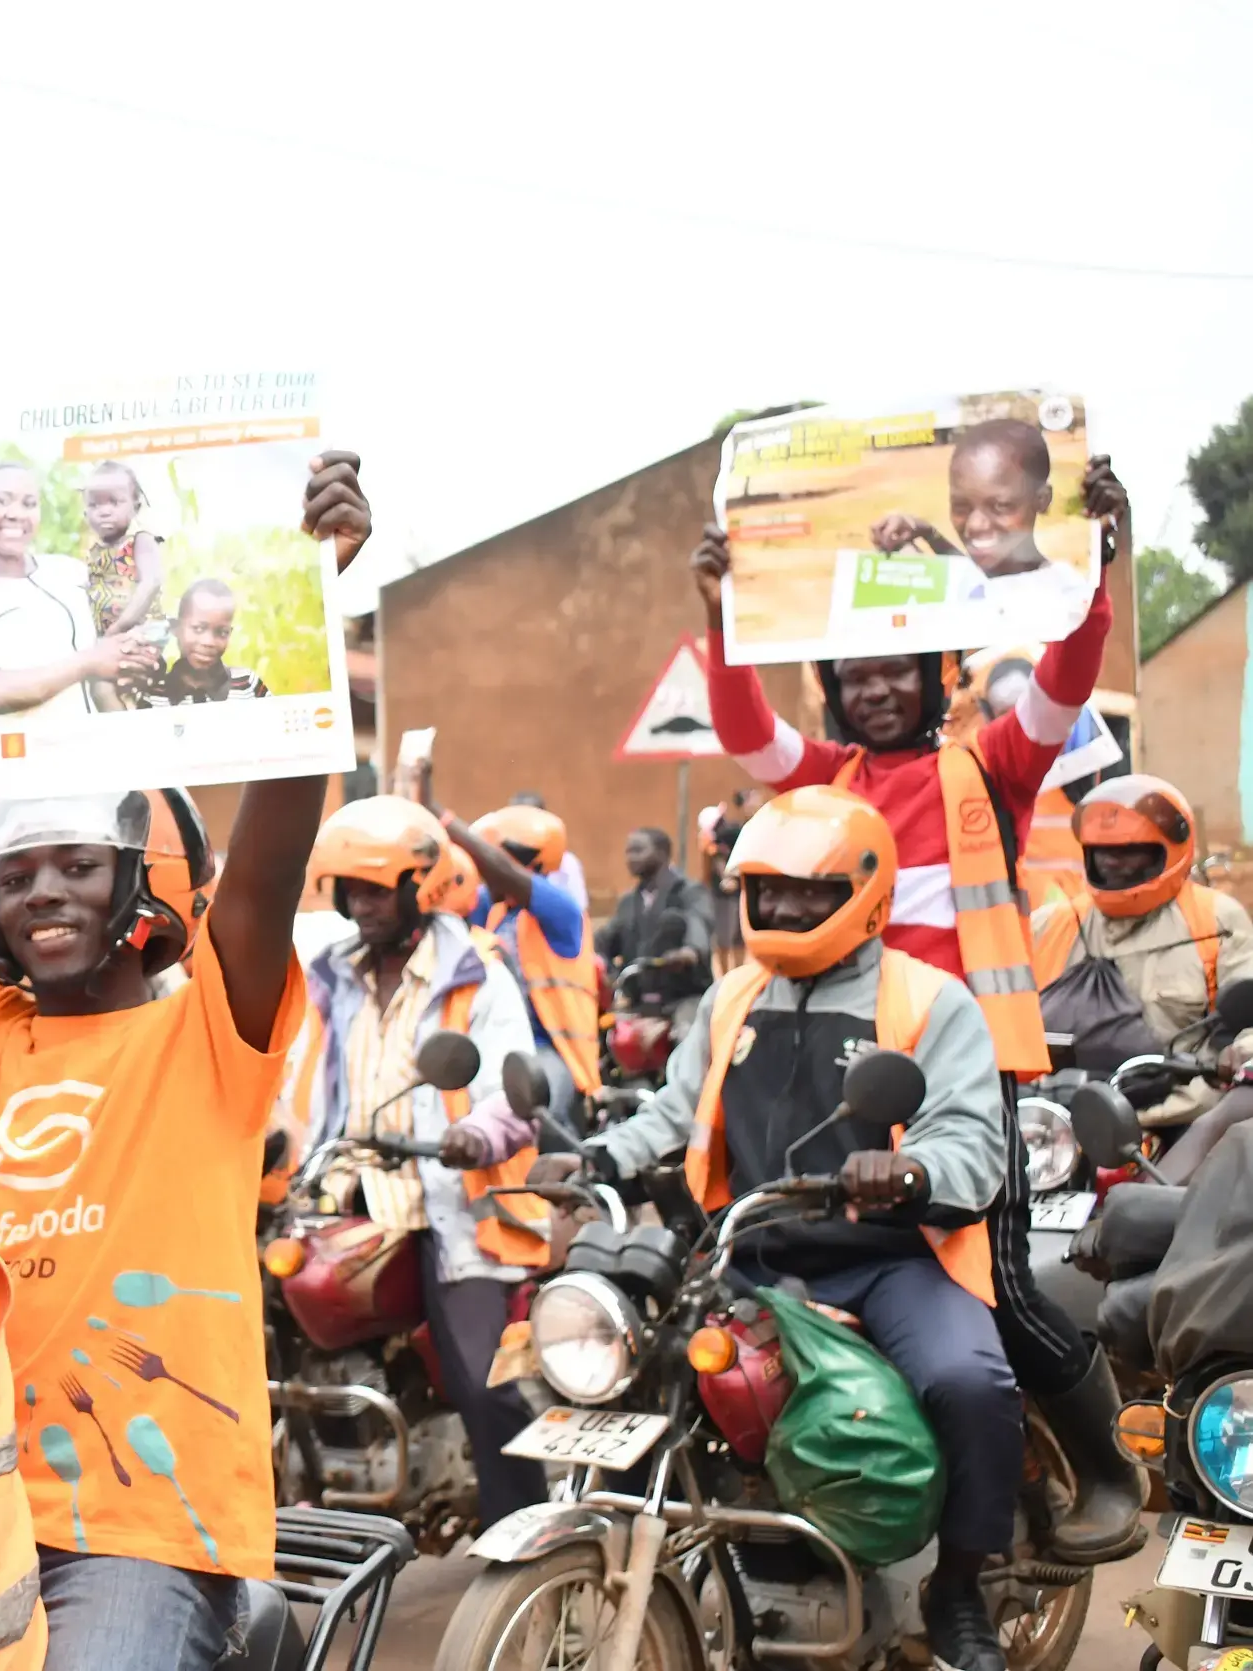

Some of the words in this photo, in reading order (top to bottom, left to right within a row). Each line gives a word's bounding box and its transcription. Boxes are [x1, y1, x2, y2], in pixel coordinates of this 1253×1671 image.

[177, 374, 194, 392] IS
[203, 373, 225, 391] TO
[233, 372, 267, 390] SEE
[275, 370, 316, 388] OUR
[19, 402, 114, 431] CHILDREN
[121, 398, 160, 421] LIVE
[168, 396, 183, 418] A
[188, 391, 265, 416] BETTER
[271, 388, 311, 410] LIFE
[866, 885, 895, 934] 67
[578, 1411, 650, 1435] UEW
[1211, 1558, 1253, 1592] 0
